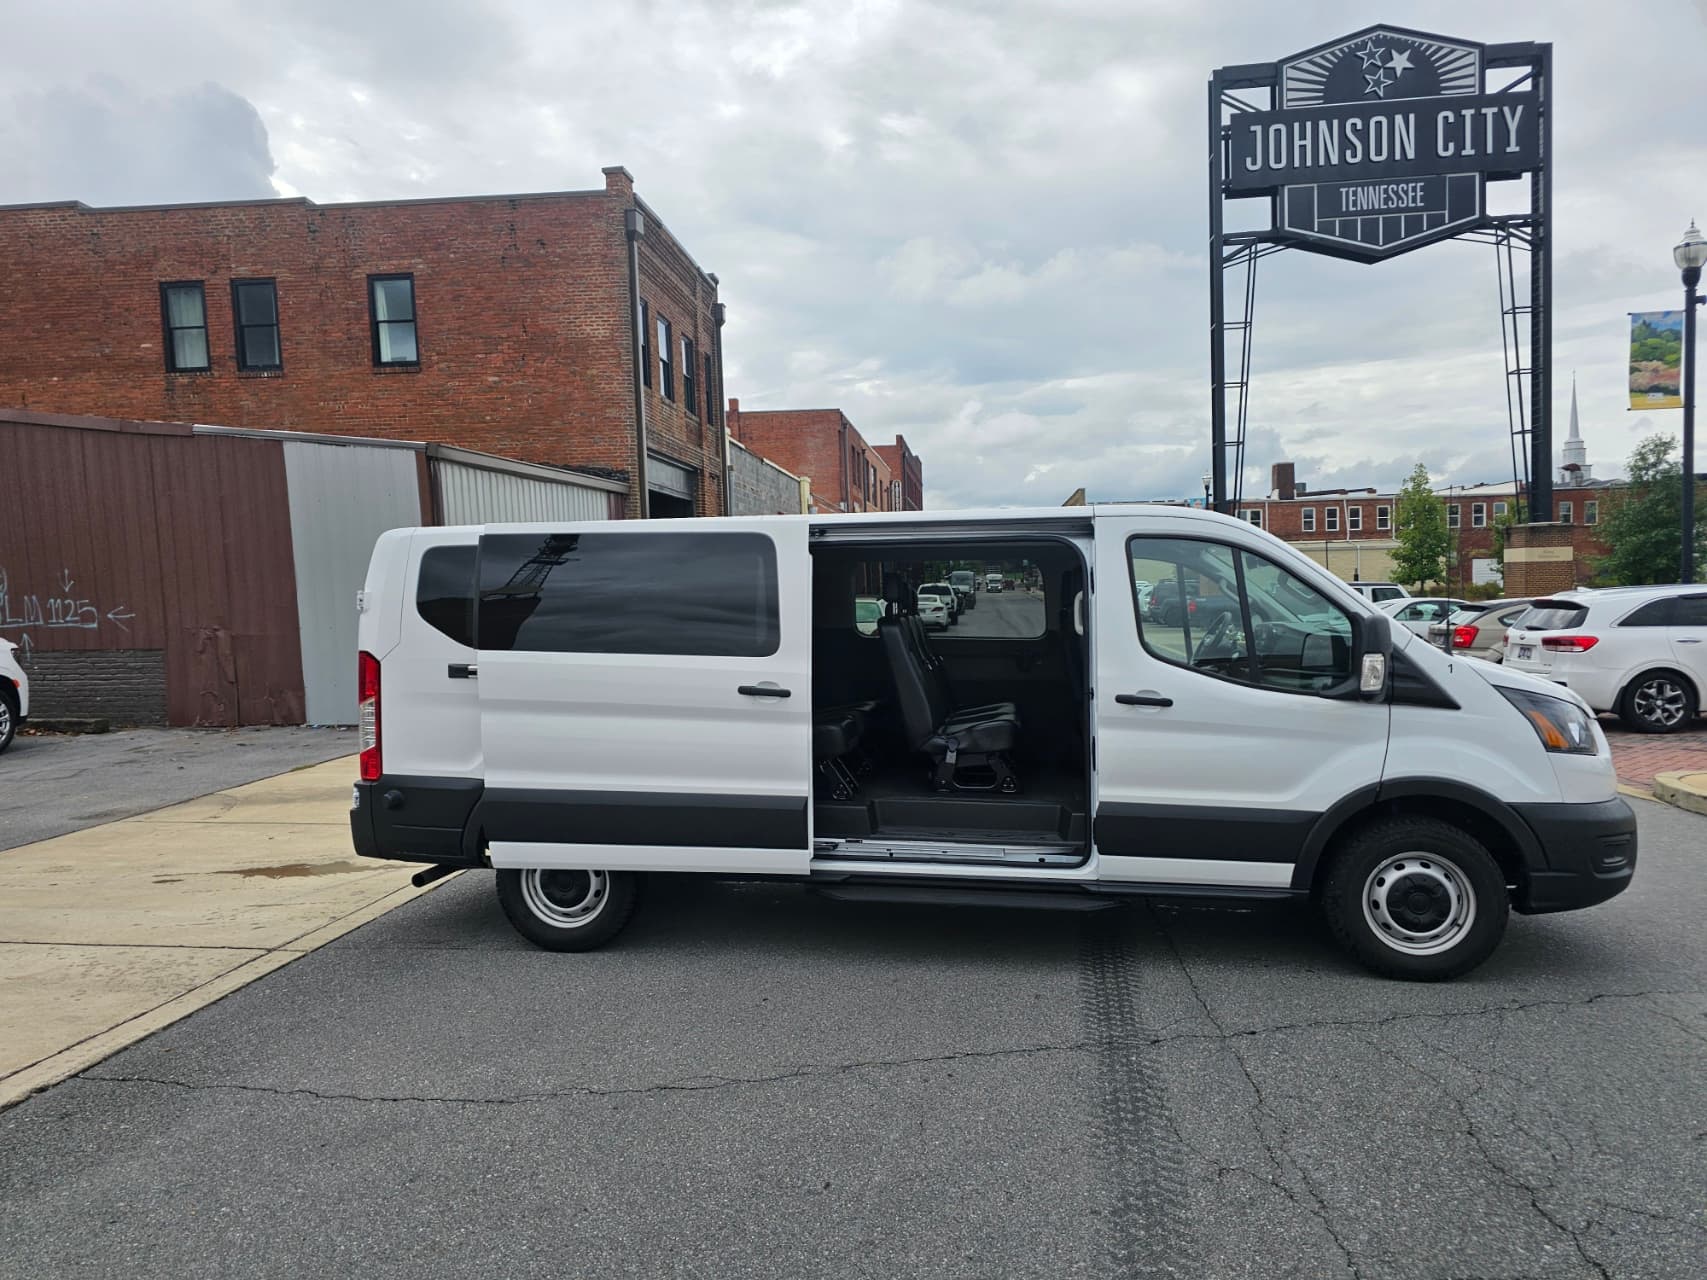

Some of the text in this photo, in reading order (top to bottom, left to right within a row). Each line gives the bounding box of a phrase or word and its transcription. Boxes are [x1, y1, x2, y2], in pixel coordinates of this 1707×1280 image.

[1246, 104, 1524, 172] JOHNSON CITY
[1339, 182, 1425, 212] TENNESSEE
[47, 598, 98, 628] 1125
[1447, 663, 1453, 674] 1
